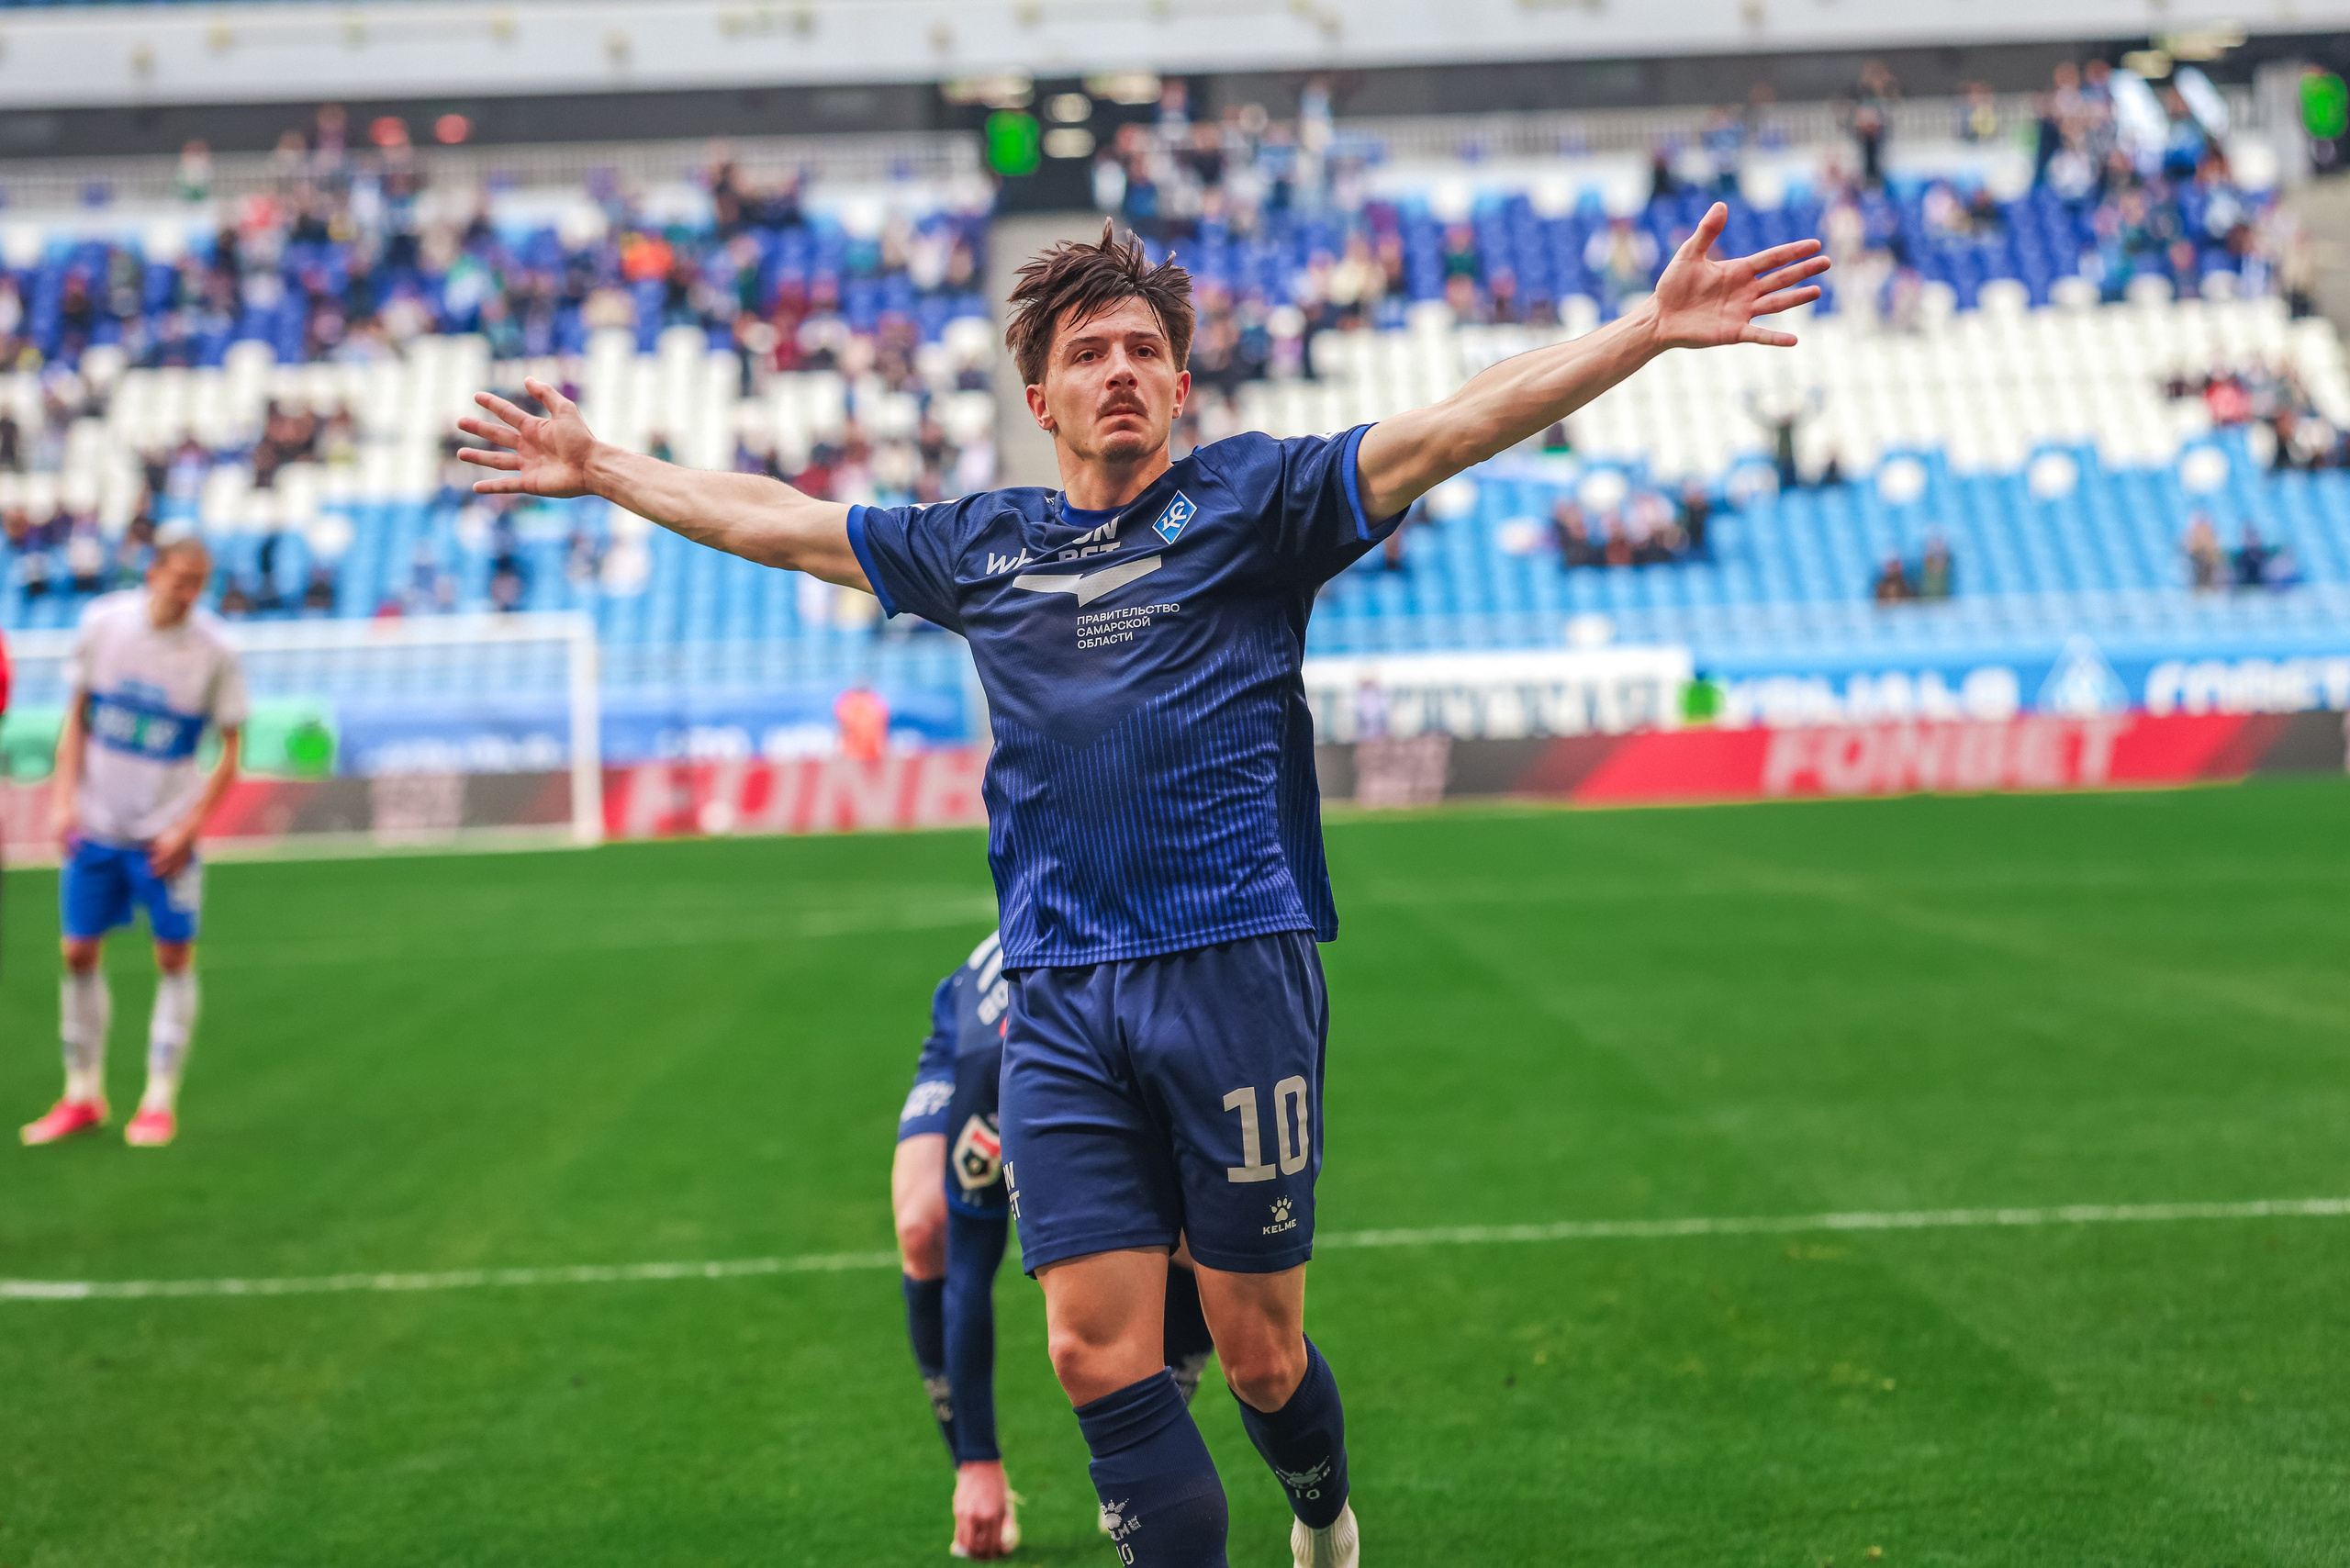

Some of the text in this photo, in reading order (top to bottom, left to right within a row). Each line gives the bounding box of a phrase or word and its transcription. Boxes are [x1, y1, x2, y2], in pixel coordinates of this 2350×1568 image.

[1077, 603, 1180, 625] ПРАВИТЕЛЬСТВО
[1077, 616, 1150, 637] САМАРСКОЙ
[1077, 632, 1134, 649] ОБЛАСТИ
[1223, 1075, 1309, 1182] 10
[1262, 1218, 1297, 1235] KELME
[1295, 1489, 1320, 1499] 10
